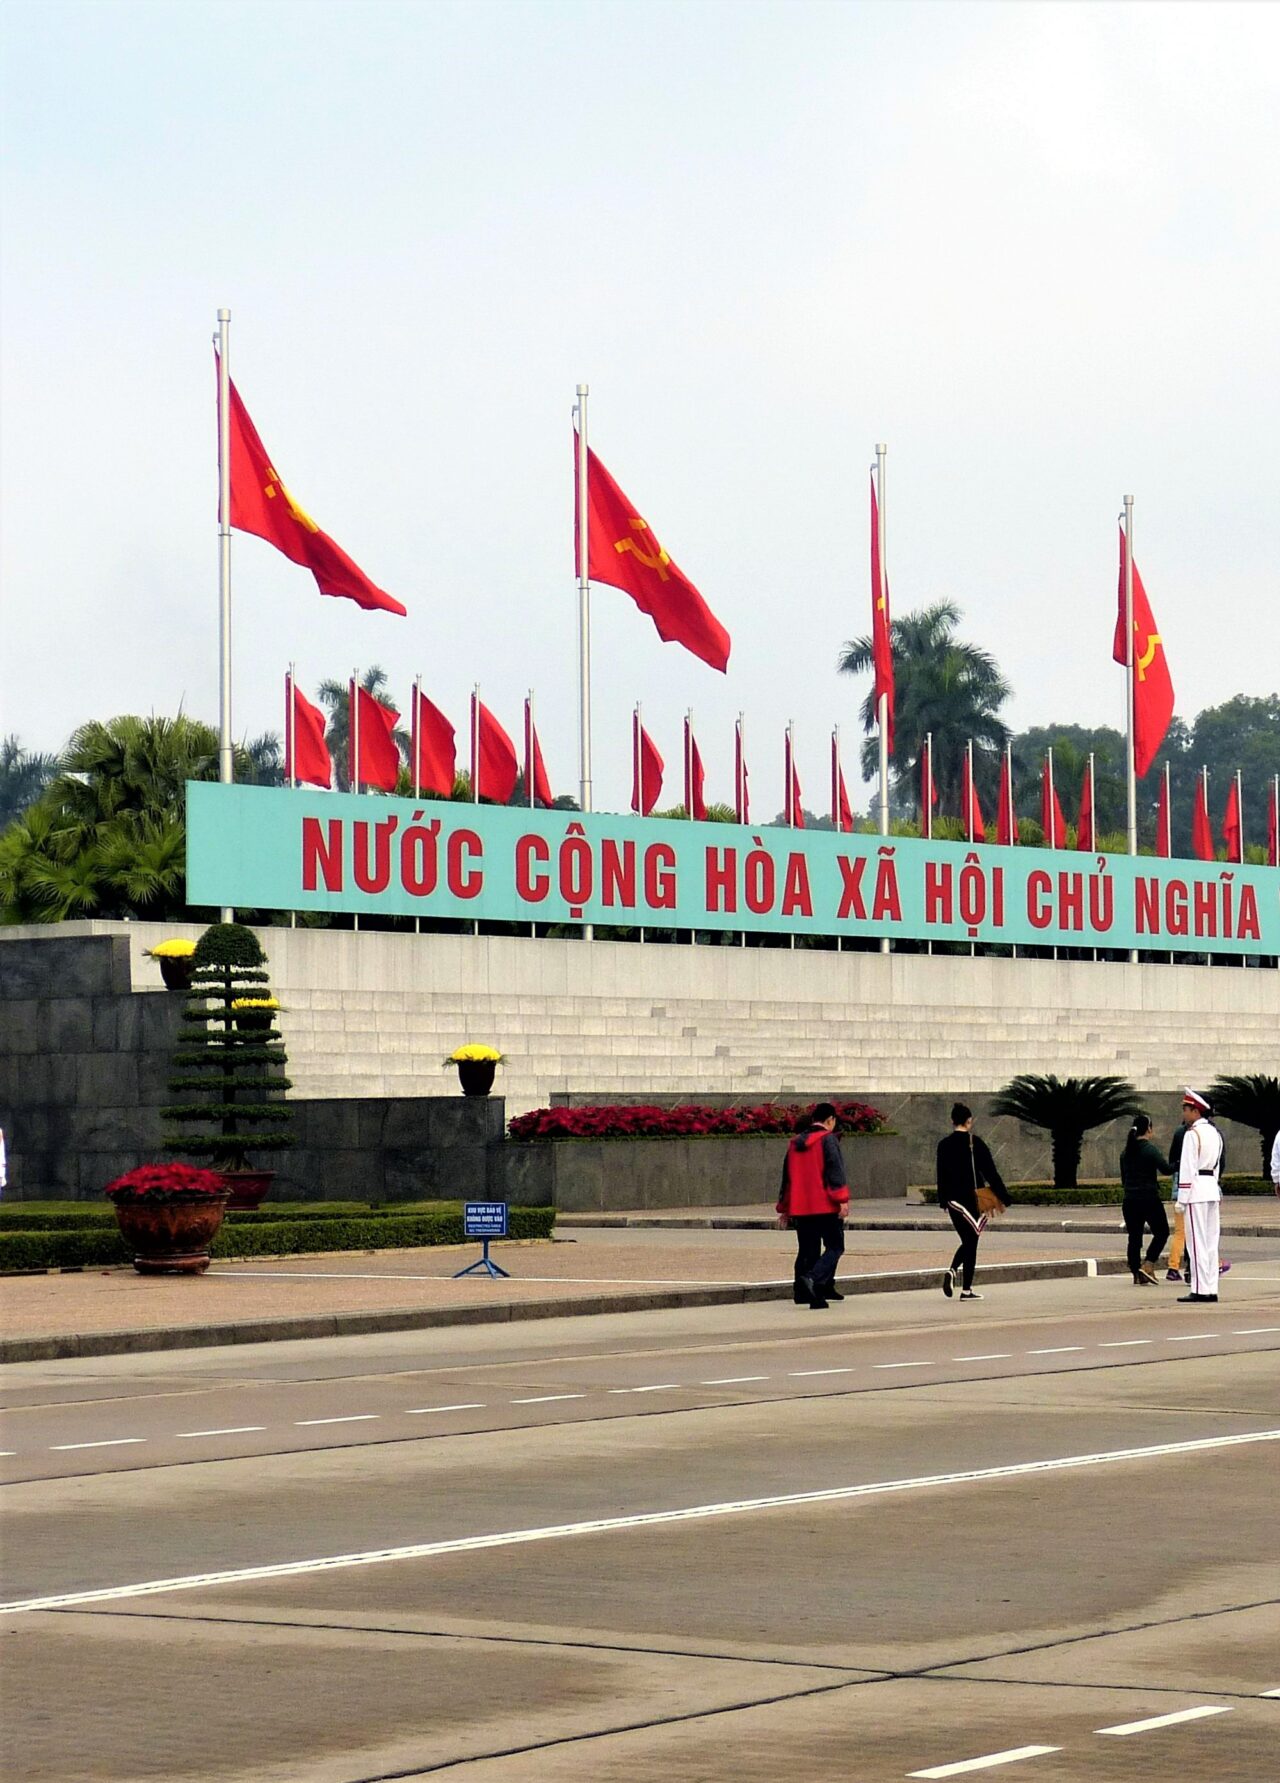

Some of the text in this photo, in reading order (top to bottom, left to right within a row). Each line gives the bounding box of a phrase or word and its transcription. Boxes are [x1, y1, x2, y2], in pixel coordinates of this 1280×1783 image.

[303, 811, 483, 899] NƯỚC
[517, 822, 676, 918] CỘNG
[707, 836, 814, 917] HÒA
[838, 847, 903, 921] XÃ
[926, 852, 1004, 937] HỘI
[1027, 855, 1113, 932] CHỦ
[1135, 872, 1260, 939] NGHĨA
